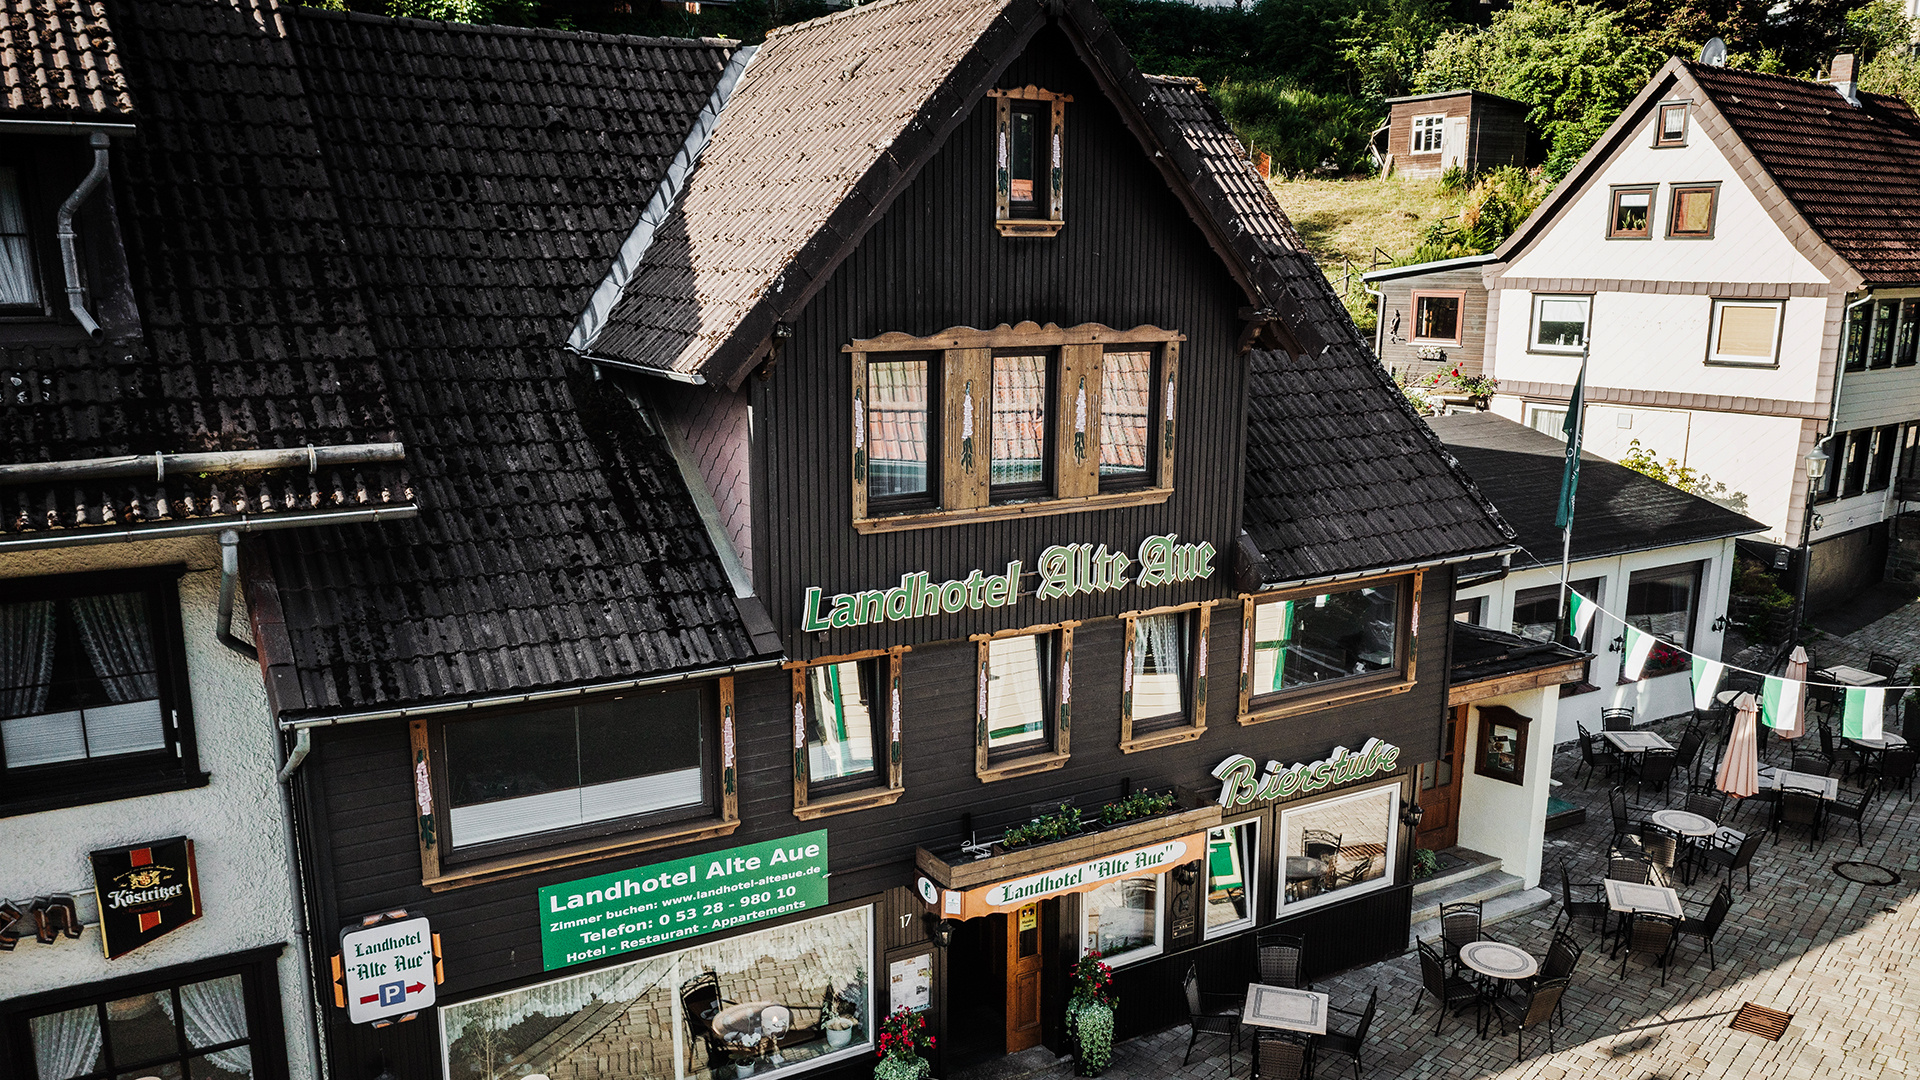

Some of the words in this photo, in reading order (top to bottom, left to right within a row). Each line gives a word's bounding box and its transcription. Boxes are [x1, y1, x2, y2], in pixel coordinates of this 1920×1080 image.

[801, 559, 1022, 633] Landhotel
[1036, 542, 1132, 602] Alte
[1136, 532, 1218, 589] Aue
[1211, 736, 1400, 809] Bierstube
[107, 883, 184, 910] Köstritzer
[549, 865, 697, 914] Landhotel
[705, 855, 762, 881] Alte
[769, 843, 821, 866] Aue
[549, 914, 604, 933] Zimmer
[605, 901, 659, 920] buchen:
[661, 866, 821, 908] www.landhotel-alteaue.de
[1001, 868, 1083, 903] Landhotel
[1088, 858, 1130, 879] "Alte
[1134, 844, 1174, 869] Aue"
[566, 945, 607, 963] Hotel
[620, 924, 700, 950] Restaurant
[711, 900, 806, 930] Appartements
[580, 919, 653, 944] Telefon:
[658, 914, 671, 926] 0
[675, 907, 697, 923] 53
[702, 902, 724, 917] 28
[739, 891, 771, 908] 980
[776, 885, 797, 900] 10
[899, 913, 913, 929] 17
[354, 931, 422, 958] Landhotel
[385, 984, 401, 1004] P
